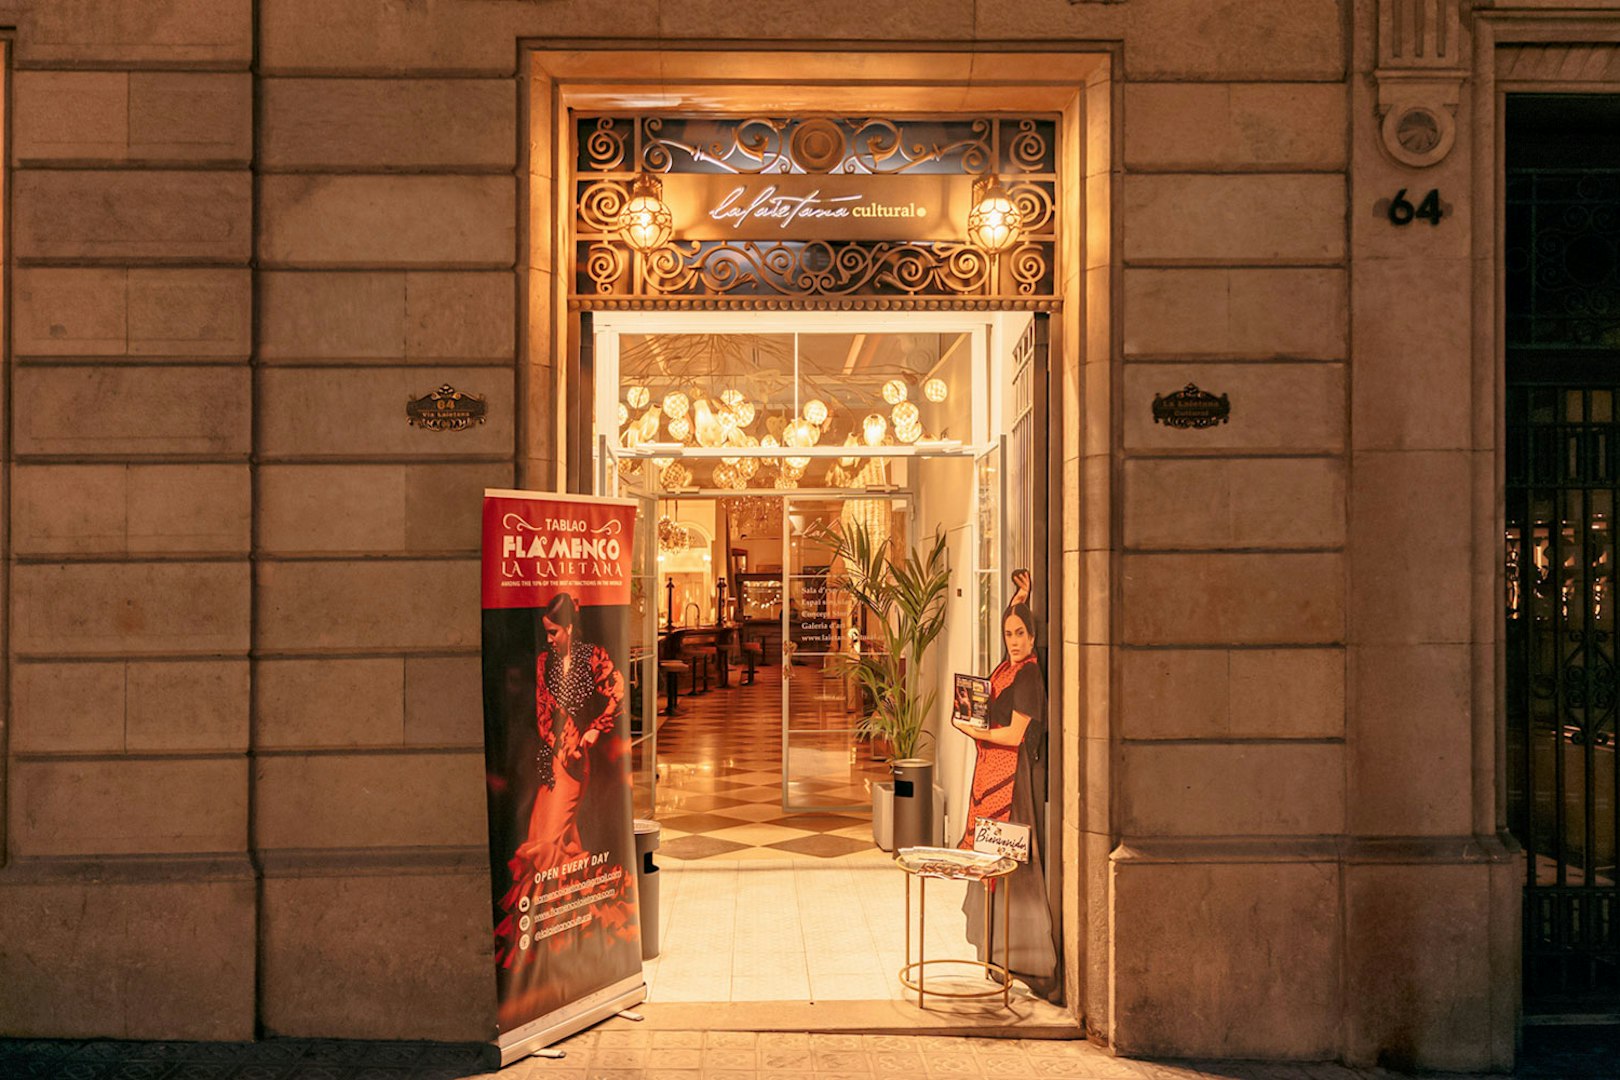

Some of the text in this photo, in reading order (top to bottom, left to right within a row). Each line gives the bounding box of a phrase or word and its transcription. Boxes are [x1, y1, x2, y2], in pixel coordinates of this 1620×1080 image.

[852, 203, 915, 218] cultural
[1388, 188, 1443, 226] 64
[437, 400, 455, 410] 64
[545, 518, 587, 532] TABLAO
[502, 535, 620, 561] FLAMENCO
[502, 561, 623, 578] LA LAIETANA
[801, 622, 828, 630] Galeria
[534, 851, 610, 885] OPEN EVERY DAY
